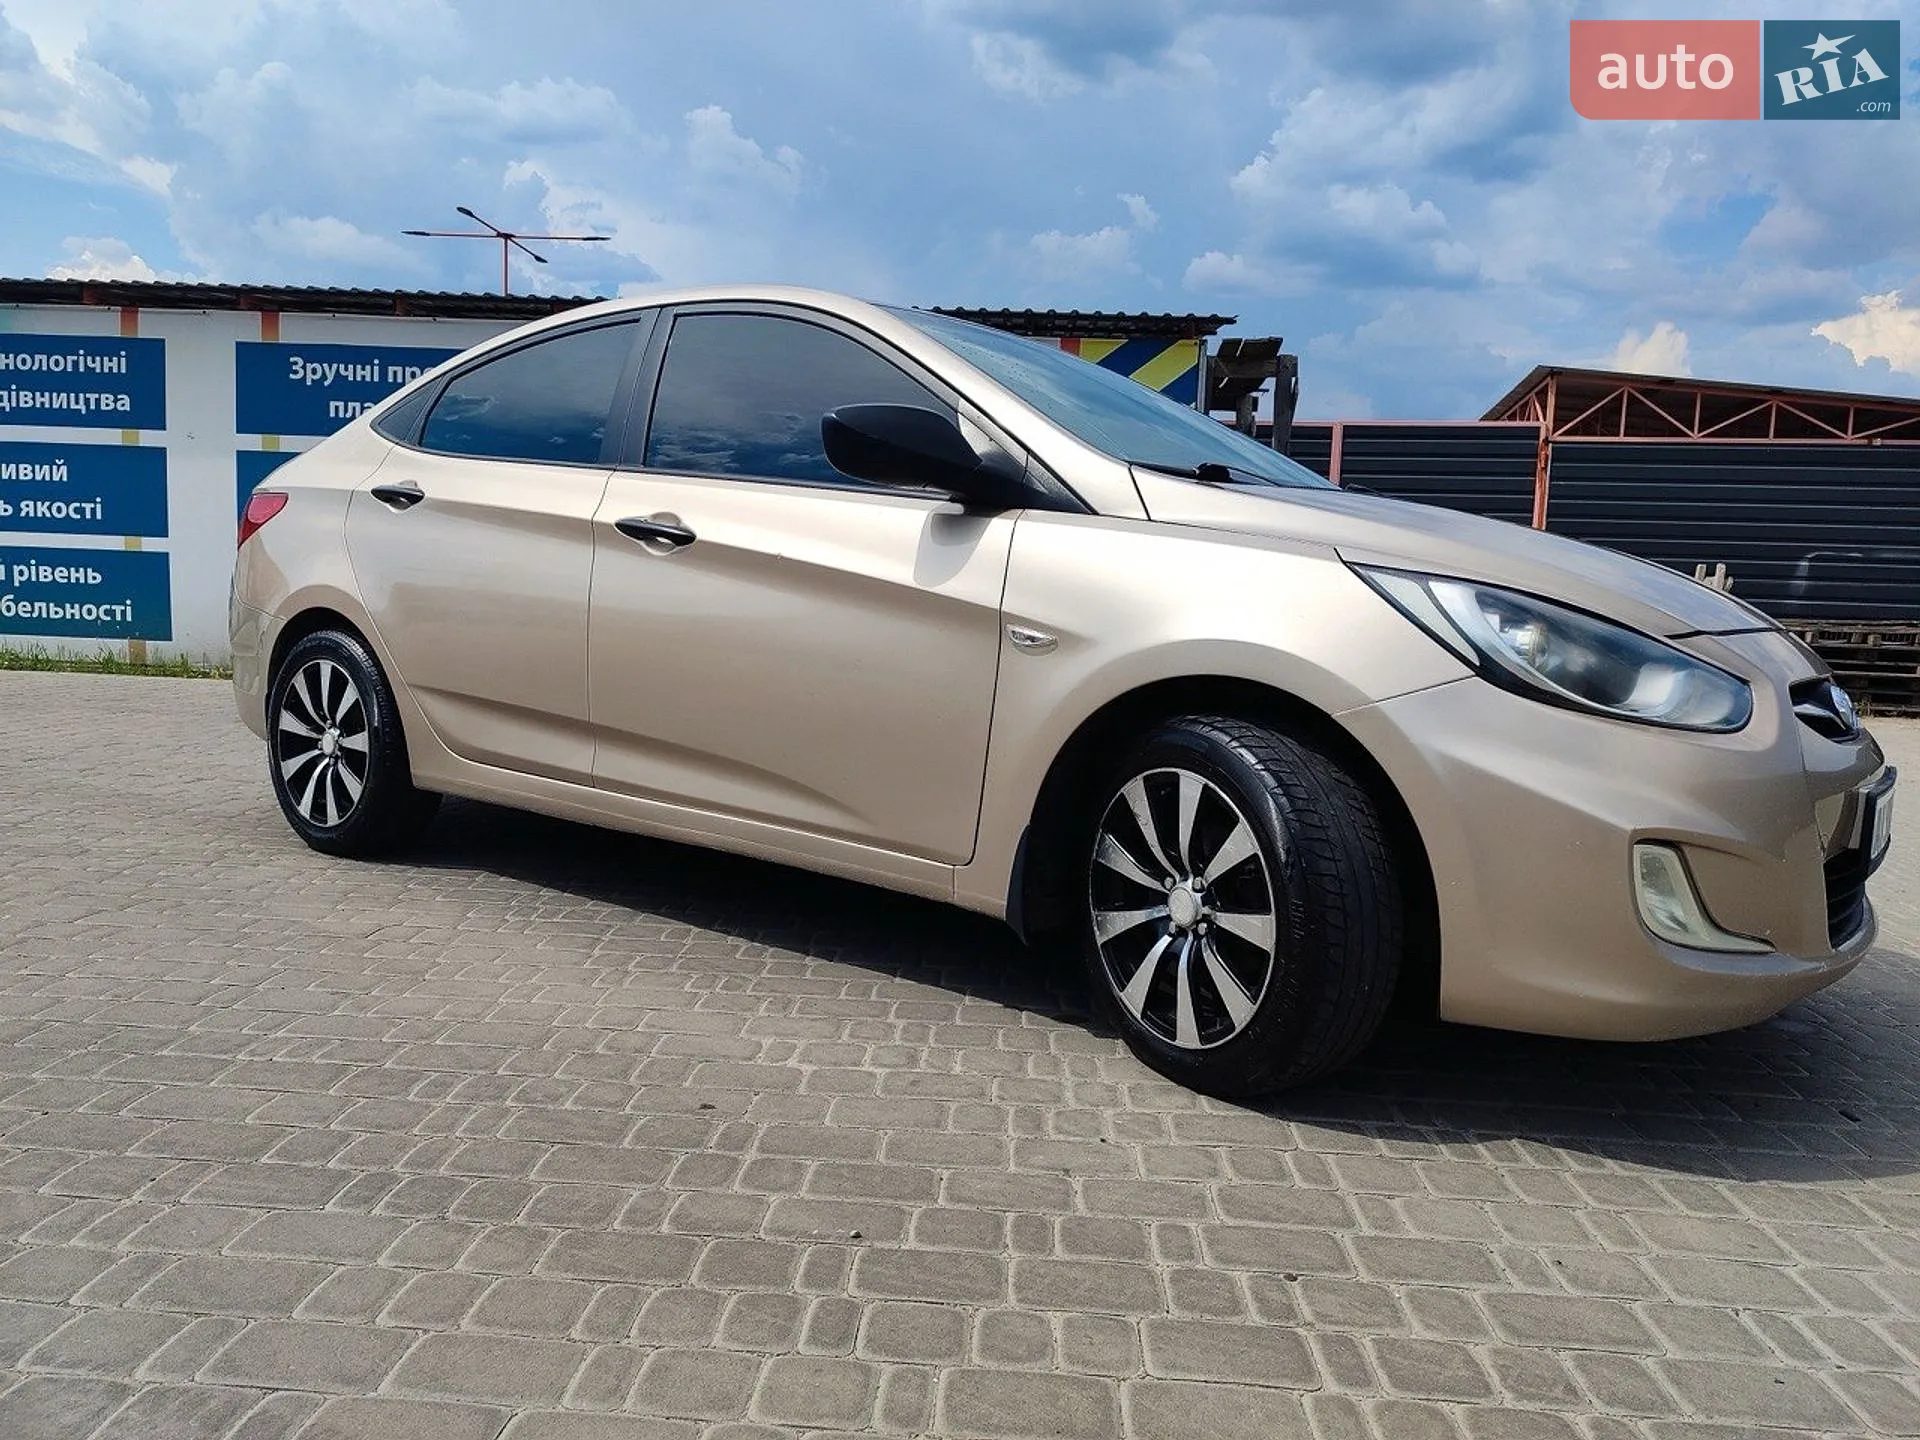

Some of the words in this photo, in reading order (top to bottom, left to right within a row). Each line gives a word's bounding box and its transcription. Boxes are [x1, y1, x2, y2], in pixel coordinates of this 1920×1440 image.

[0, 350, 127, 373] нологічні
[289, 357, 379, 387] Зручні
[1, 459, 68, 482] ивий
[19, 497, 102, 520] якості
[13, 559, 103, 587] рівень
[1, 594, 132, 622] бельності
